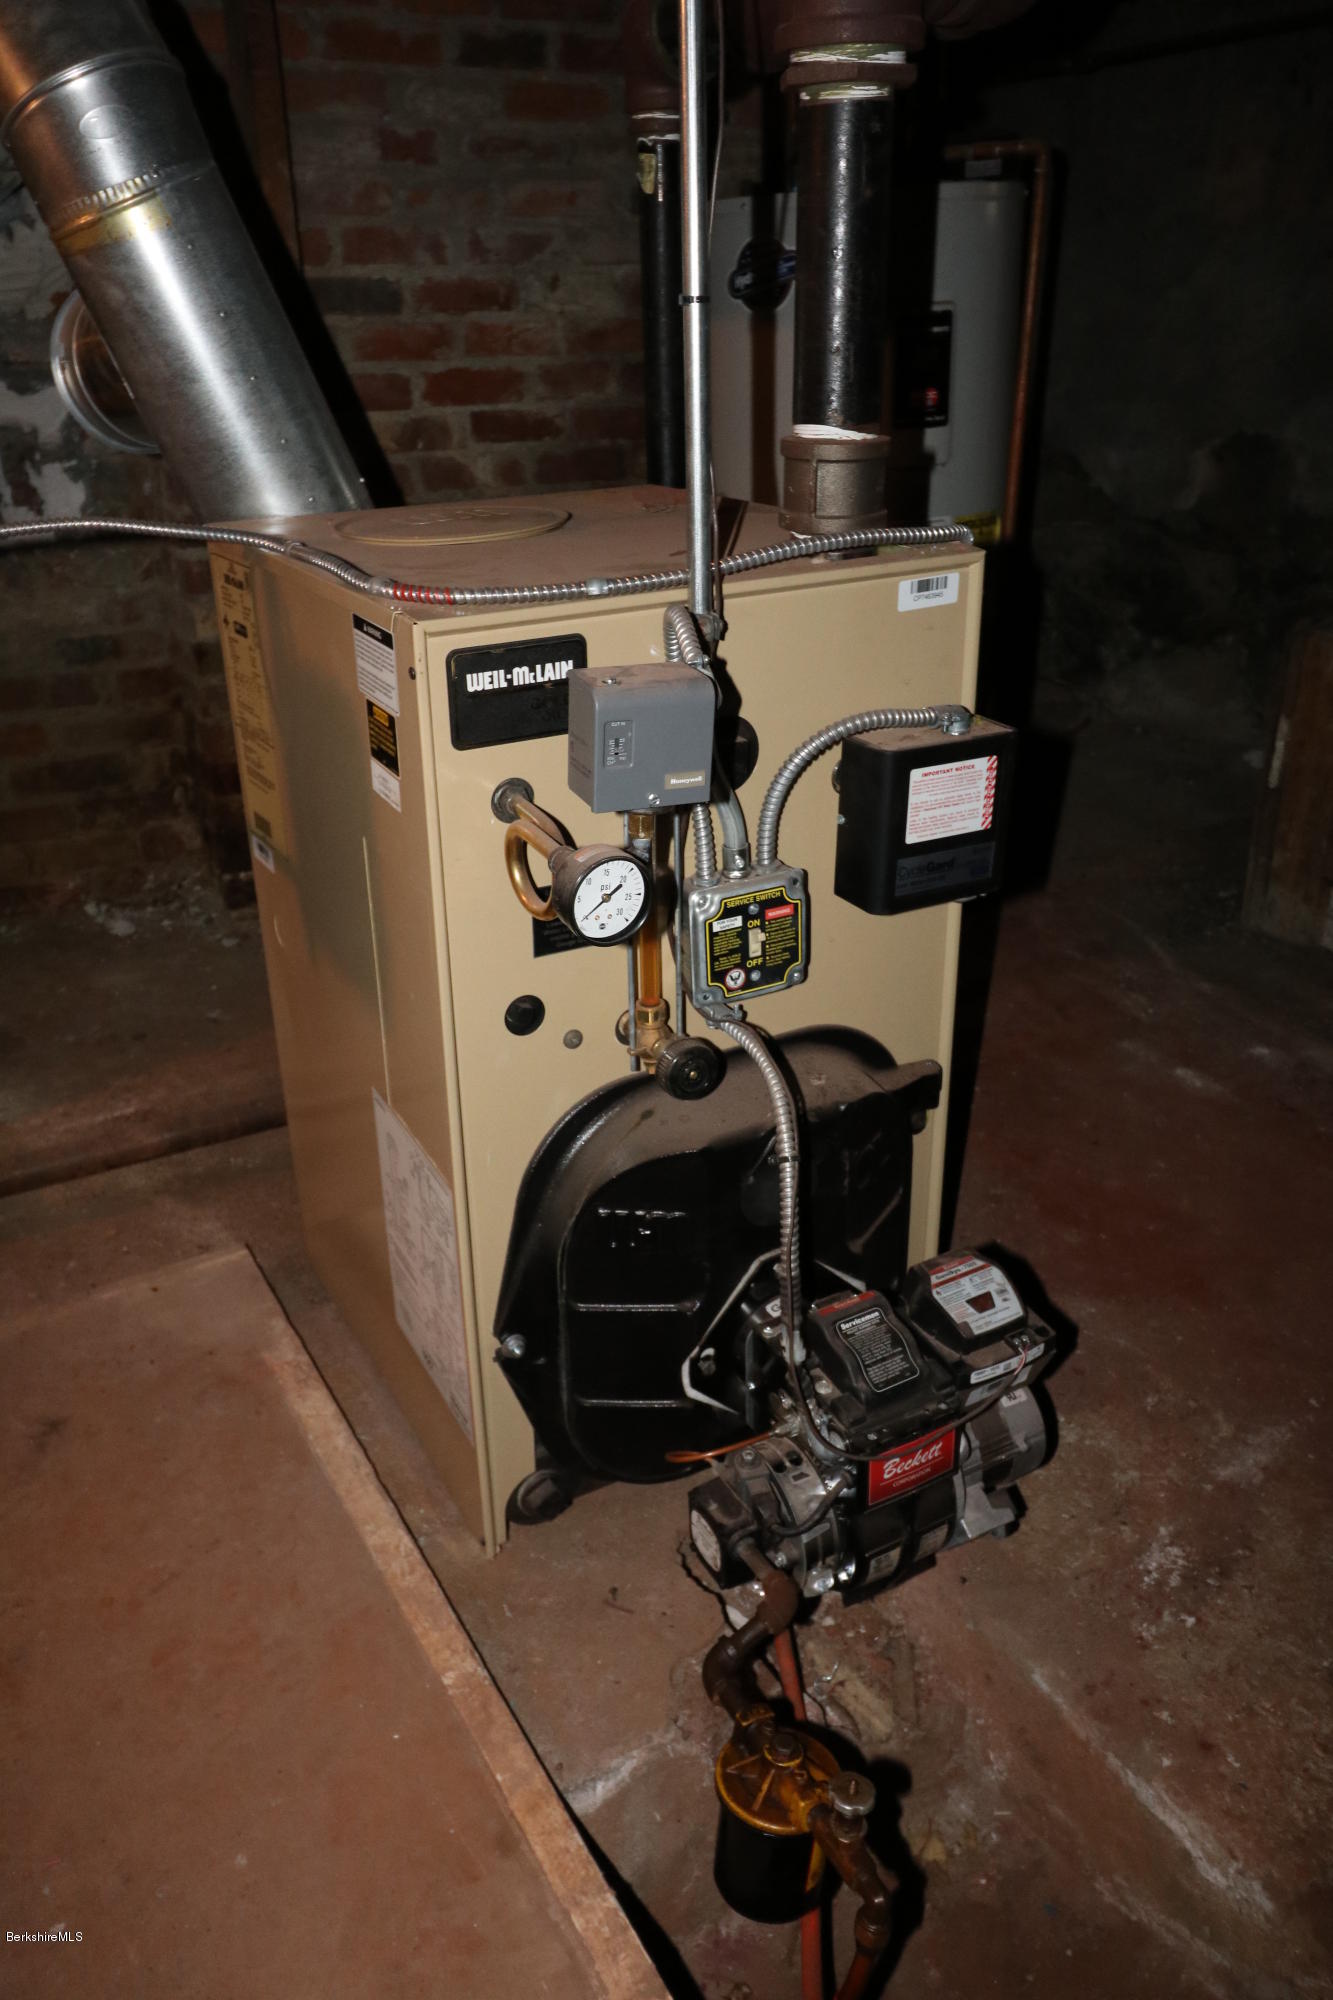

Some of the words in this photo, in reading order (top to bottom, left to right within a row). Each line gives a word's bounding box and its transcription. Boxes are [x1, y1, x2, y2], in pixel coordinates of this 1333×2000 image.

[922, 768, 953, 777] IMPORTANT
[955, 764, 975, 772] NOTICE
[670, 776, 703, 785] Honeywell
[604, 869, 610, 877] 15
[619, 875, 627, 883] 20
[625, 893, 632, 901] 25
[727, 896, 754, 908] SERVICE
[756, 891, 781, 902] SWITCH
[616, 908, 623, 916] 30
[747, 919, 760, 928] ON
[746, 957, 763, 968] OFF
[883, 1440, 943, 1479] Beckett
